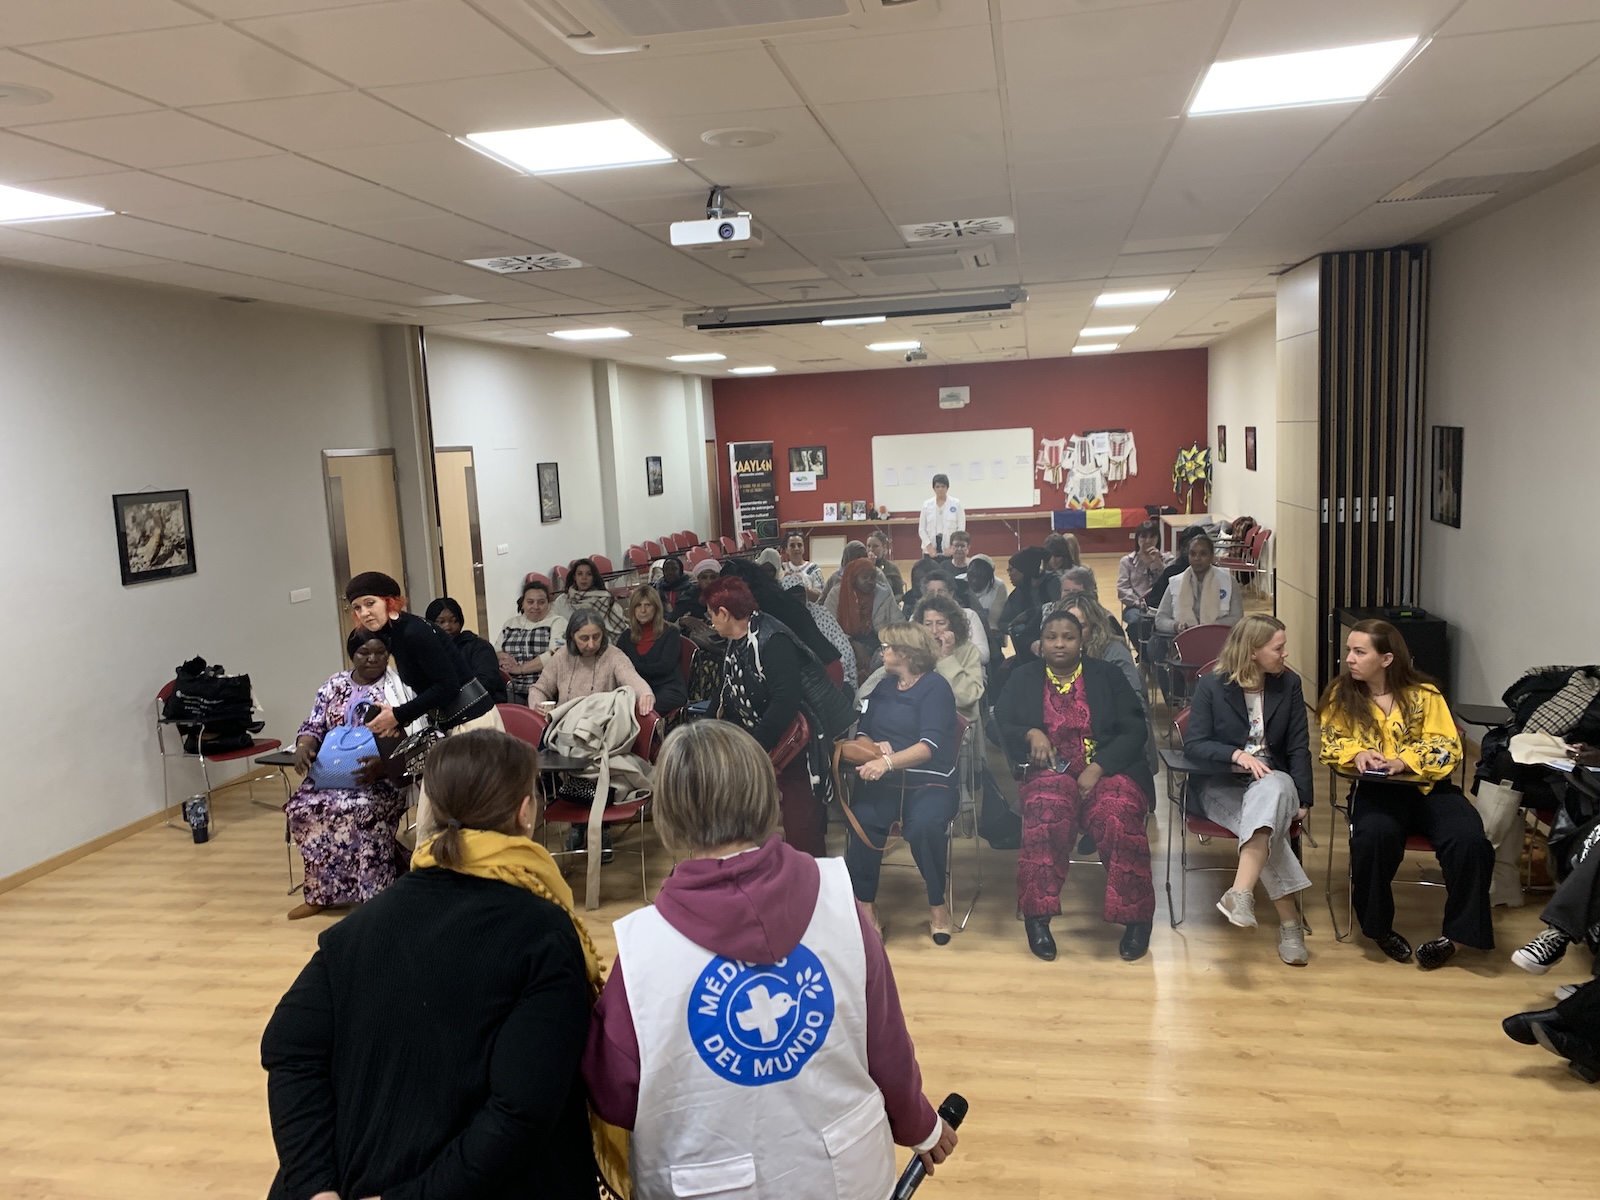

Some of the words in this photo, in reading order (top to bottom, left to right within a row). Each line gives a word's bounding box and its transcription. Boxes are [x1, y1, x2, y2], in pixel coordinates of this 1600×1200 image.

[698, 957, 788, 1017] MÉDI
[703, 1033, 743, 1076] DEL
[754, 1010, 824, 1078] MUNDO
